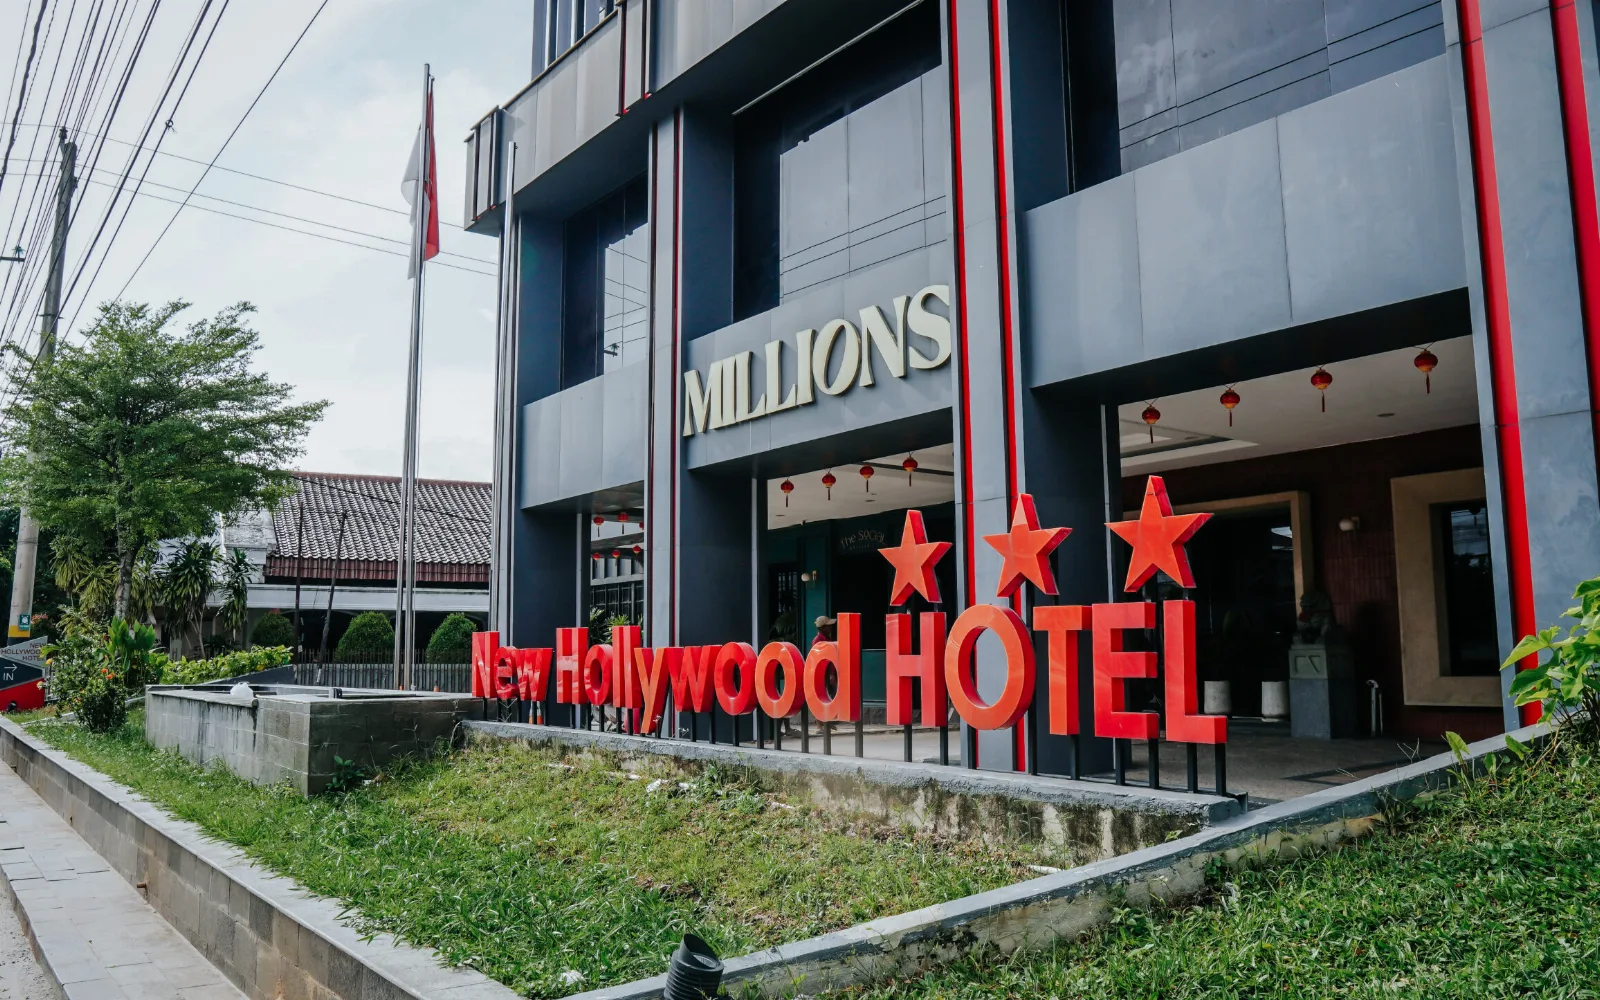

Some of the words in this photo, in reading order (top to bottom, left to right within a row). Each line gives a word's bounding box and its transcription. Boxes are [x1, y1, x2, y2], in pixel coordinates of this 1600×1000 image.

[682, 284, 951, 437] MILLIONS
[3, 672, 14, 680] IN
[472, 631, 553, 701] New
[556, 612, 861, 734] Hollywood
[886, 600, 1228, 744] HOTEL
